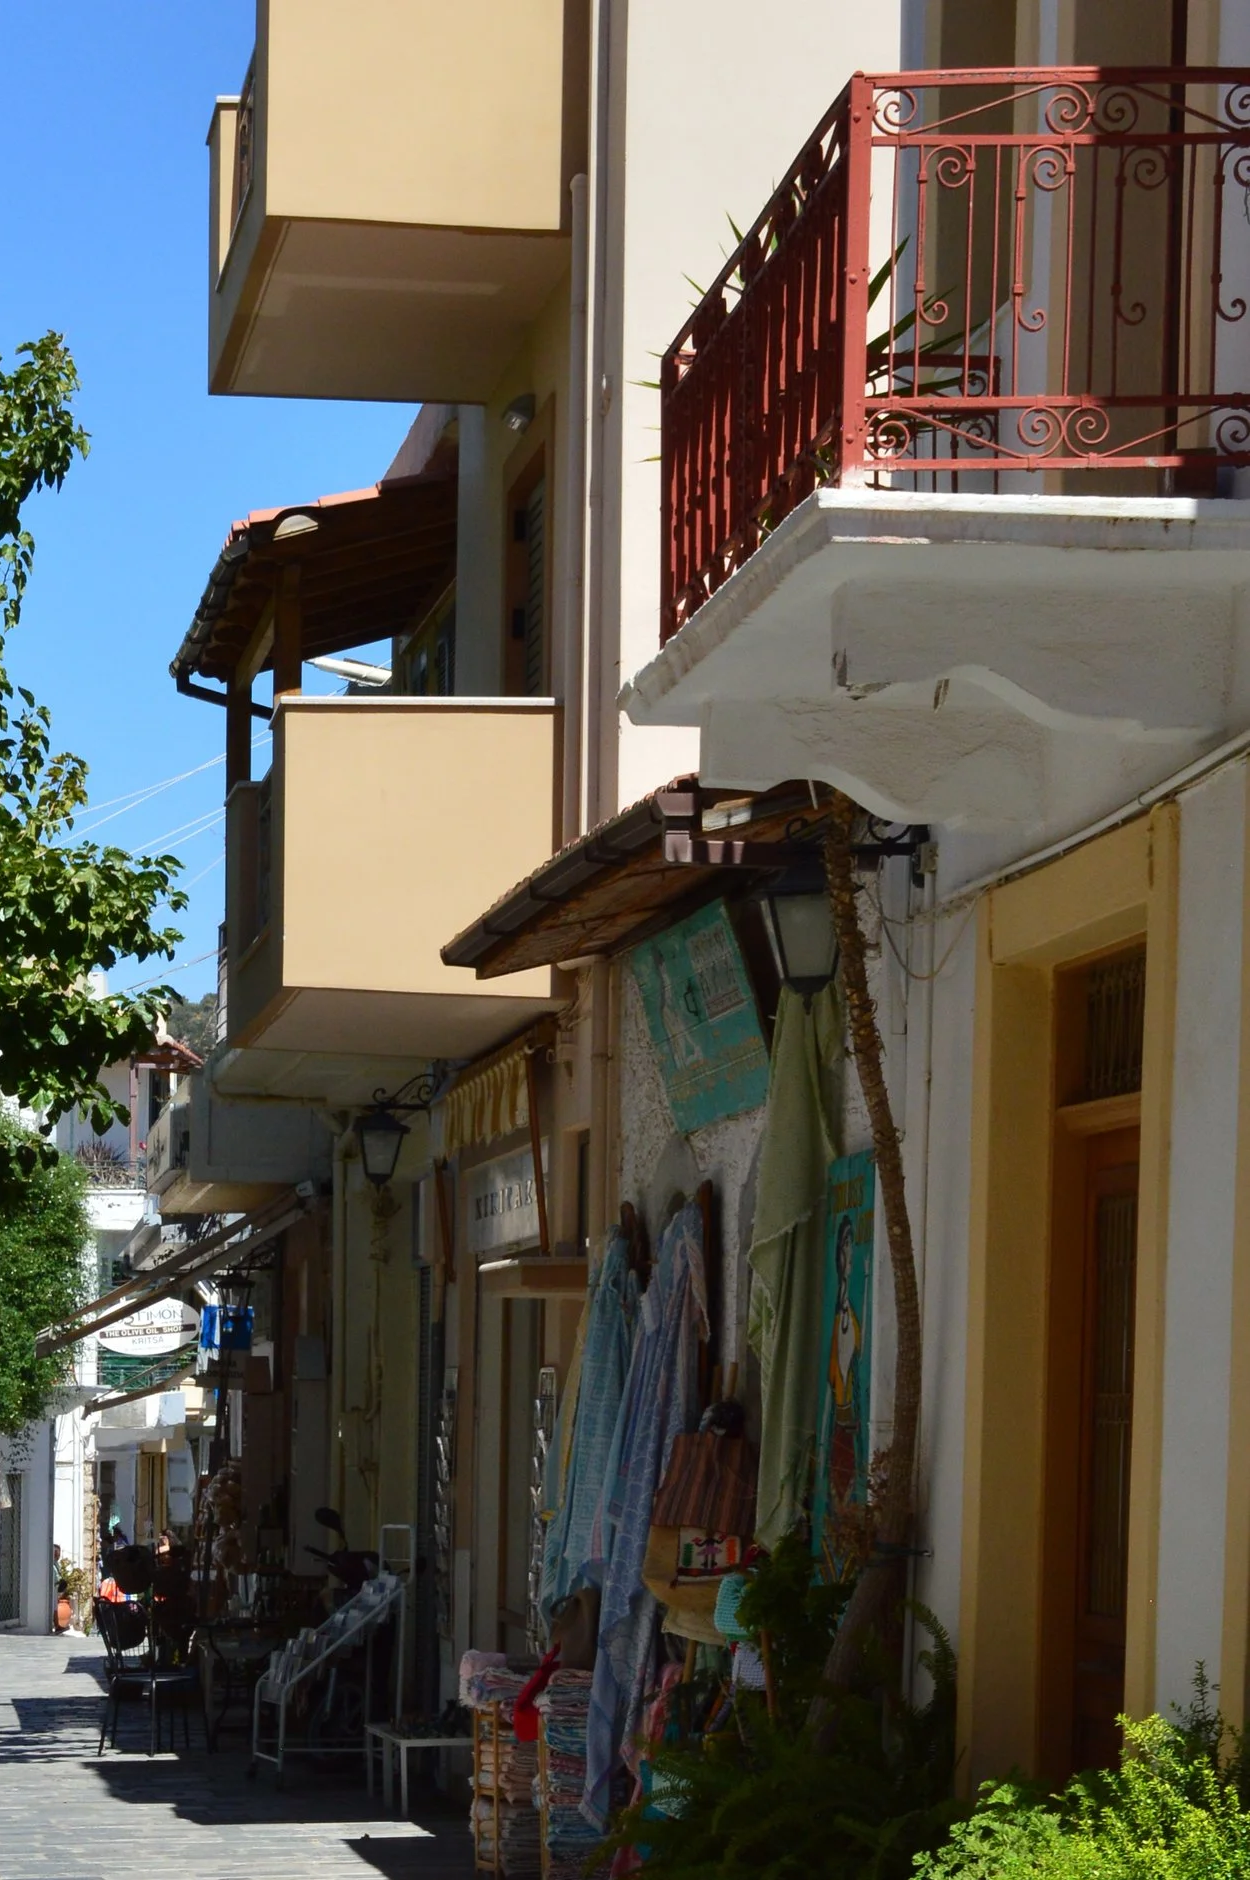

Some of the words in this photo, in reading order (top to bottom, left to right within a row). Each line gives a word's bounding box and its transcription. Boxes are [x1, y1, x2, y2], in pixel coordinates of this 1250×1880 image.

[105, 1330, 120, 1338] THE
[121, 1328, 144, 1337] OLIVE
[145, 1327, 159, 1335] OIL
[162, 1324, 183, 1333] SHOP
[131, 1336, 164, 1345] KRITSA
